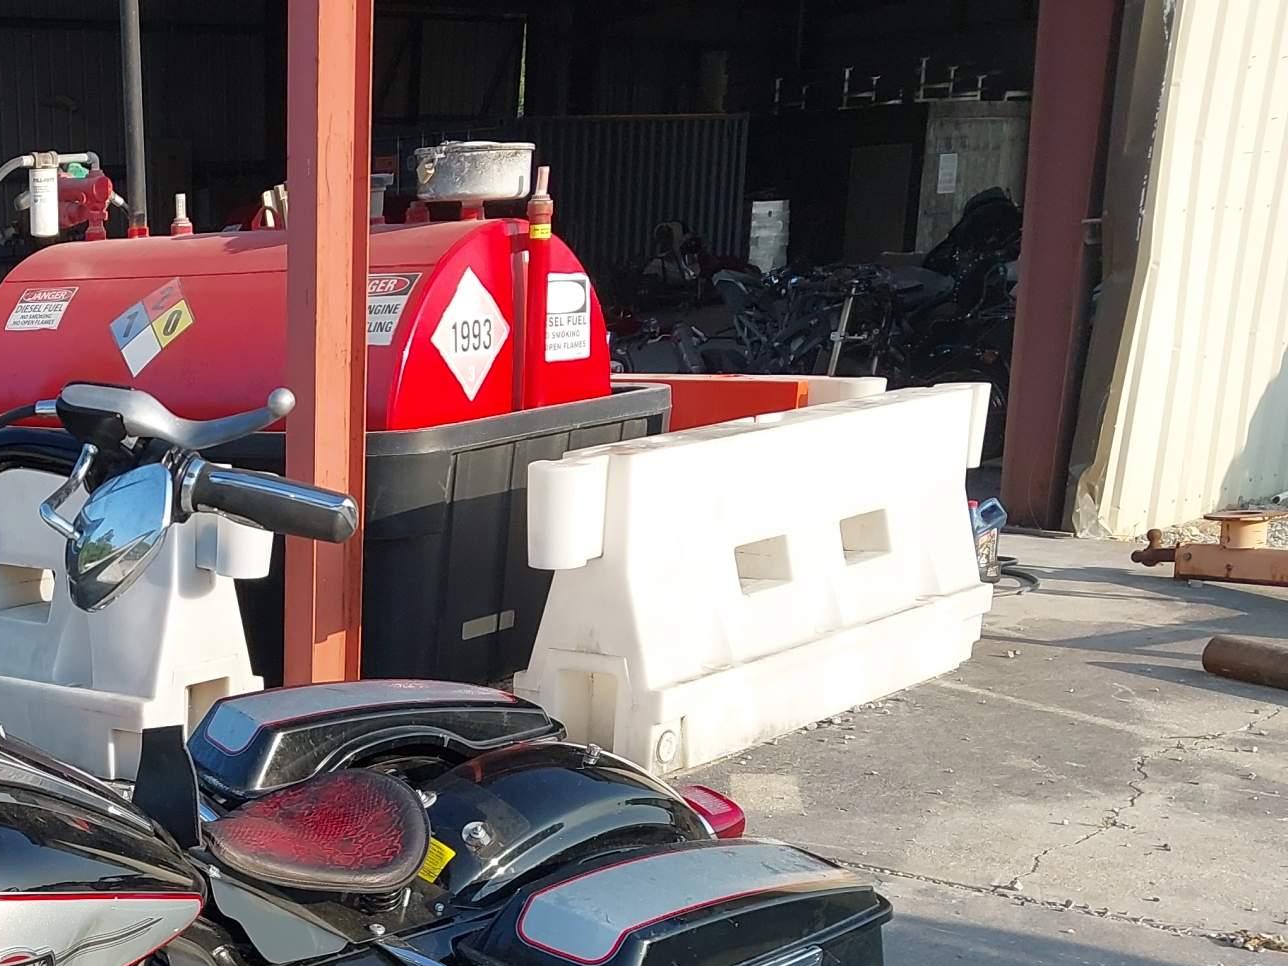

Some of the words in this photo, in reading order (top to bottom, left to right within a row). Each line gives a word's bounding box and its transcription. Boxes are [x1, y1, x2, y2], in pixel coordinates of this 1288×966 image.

[368, 280, 397, 292] GER
[152, 286, 174, 310] 2
[15, 304, 43, 313] DIESEL
[43, 303, 64, 312] FUEL
[368, 304, 400, 314] NGINE
[123, 311, 139, 337] 1
[163, 309, 182, 336] 0
[368, 321, 393, 333] LING
[548, 316, 565, 327] SEL
[567, 315, 587, 326] FUEL
[451, 318, 492, 353] 1993
